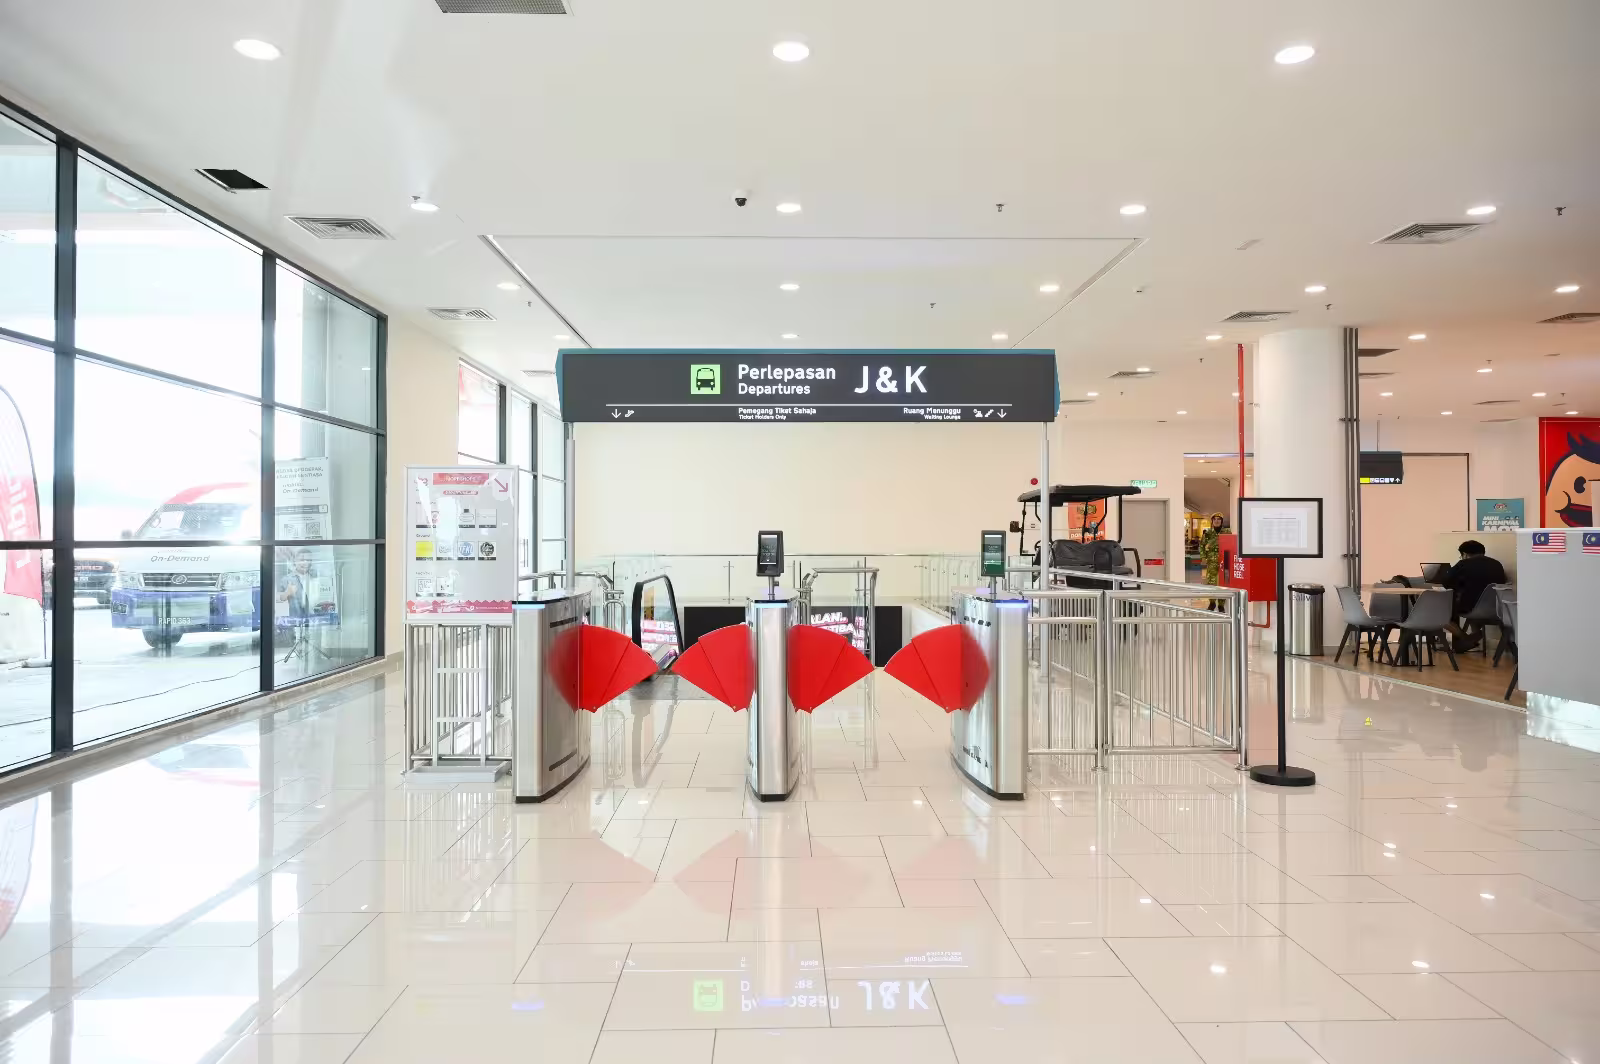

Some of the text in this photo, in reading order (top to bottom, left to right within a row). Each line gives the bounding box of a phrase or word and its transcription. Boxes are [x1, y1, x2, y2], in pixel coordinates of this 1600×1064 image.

[738, 363, 836, 381] Perlepasan
[854, 365, 928, 394] J & K
[738, 383, 811, 395] Departures
[738, 407, 817, 416] Pemegang Tiket Sahaja
[903, 407, 962, 416] Ruang Menunggu
[150, 553, 211, 563] On-Demand
